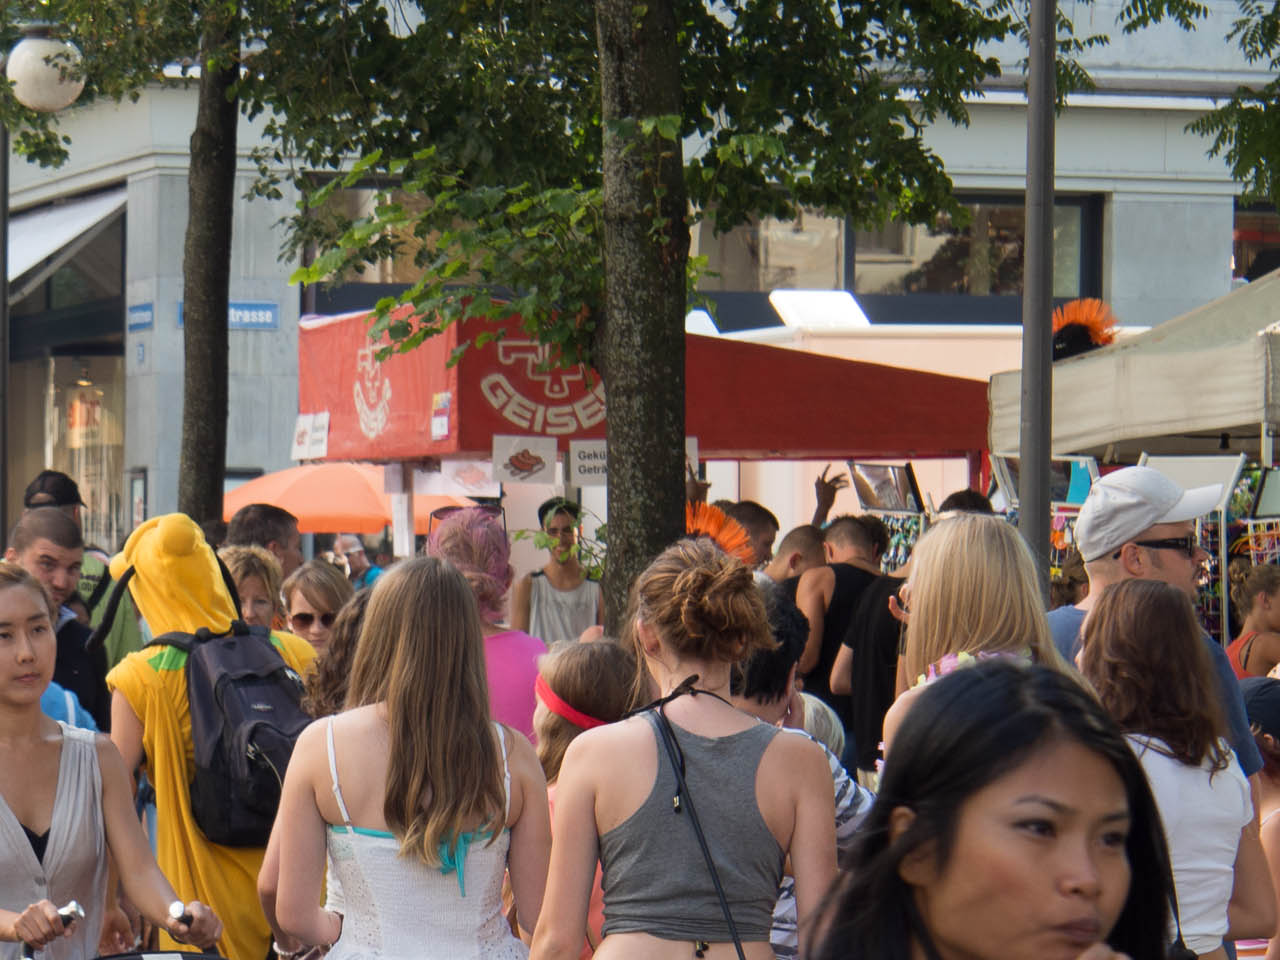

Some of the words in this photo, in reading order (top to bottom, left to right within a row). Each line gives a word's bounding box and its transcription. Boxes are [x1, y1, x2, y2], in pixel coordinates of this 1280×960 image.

[228, 308, 273, 323] trasse
[480, 373, 607, 435] GEISE
[578, 450, 607, 461] Gekü
[578, 464, 608, 475] Geträ
